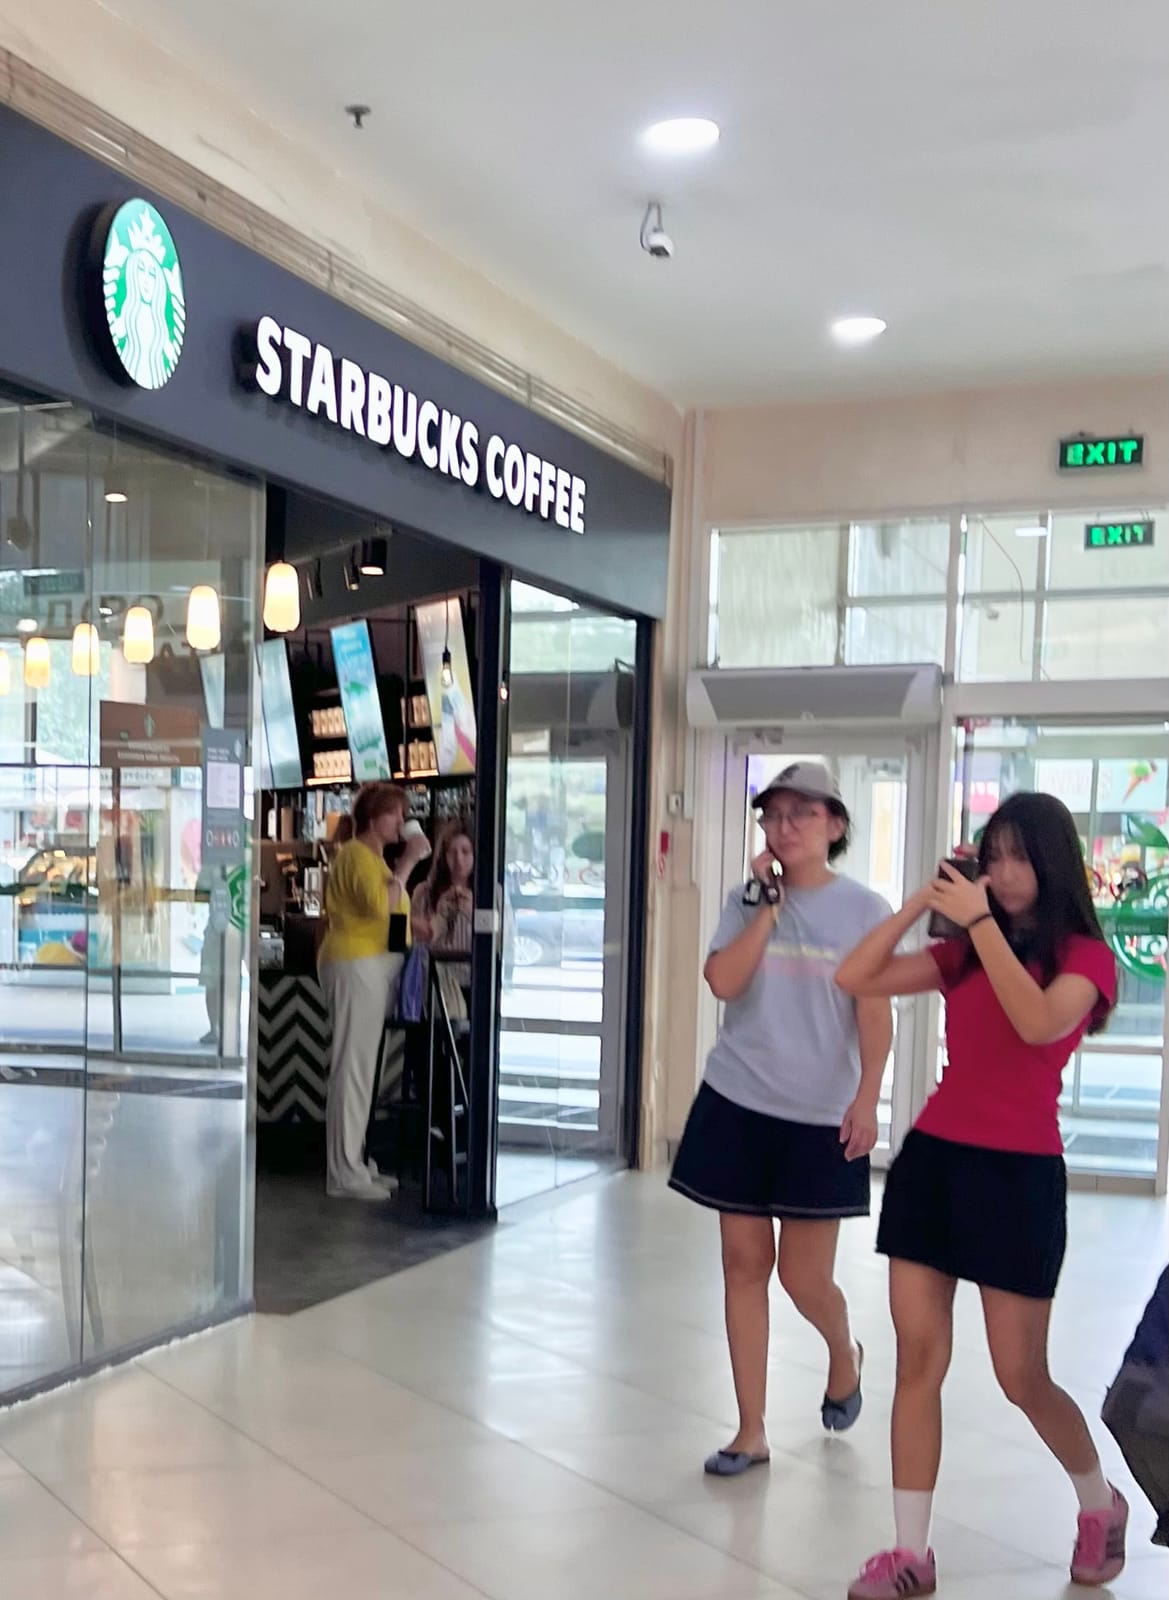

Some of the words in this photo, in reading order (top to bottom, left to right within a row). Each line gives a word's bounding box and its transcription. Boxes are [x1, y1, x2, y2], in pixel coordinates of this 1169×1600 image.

[255, 316, 479, 487] STARBUCKS
[486, 434, 586, 534] COFFEE
[1066, 439, 1138, 466] EXIT
[1090, 523, 1145, 546] EXIT
